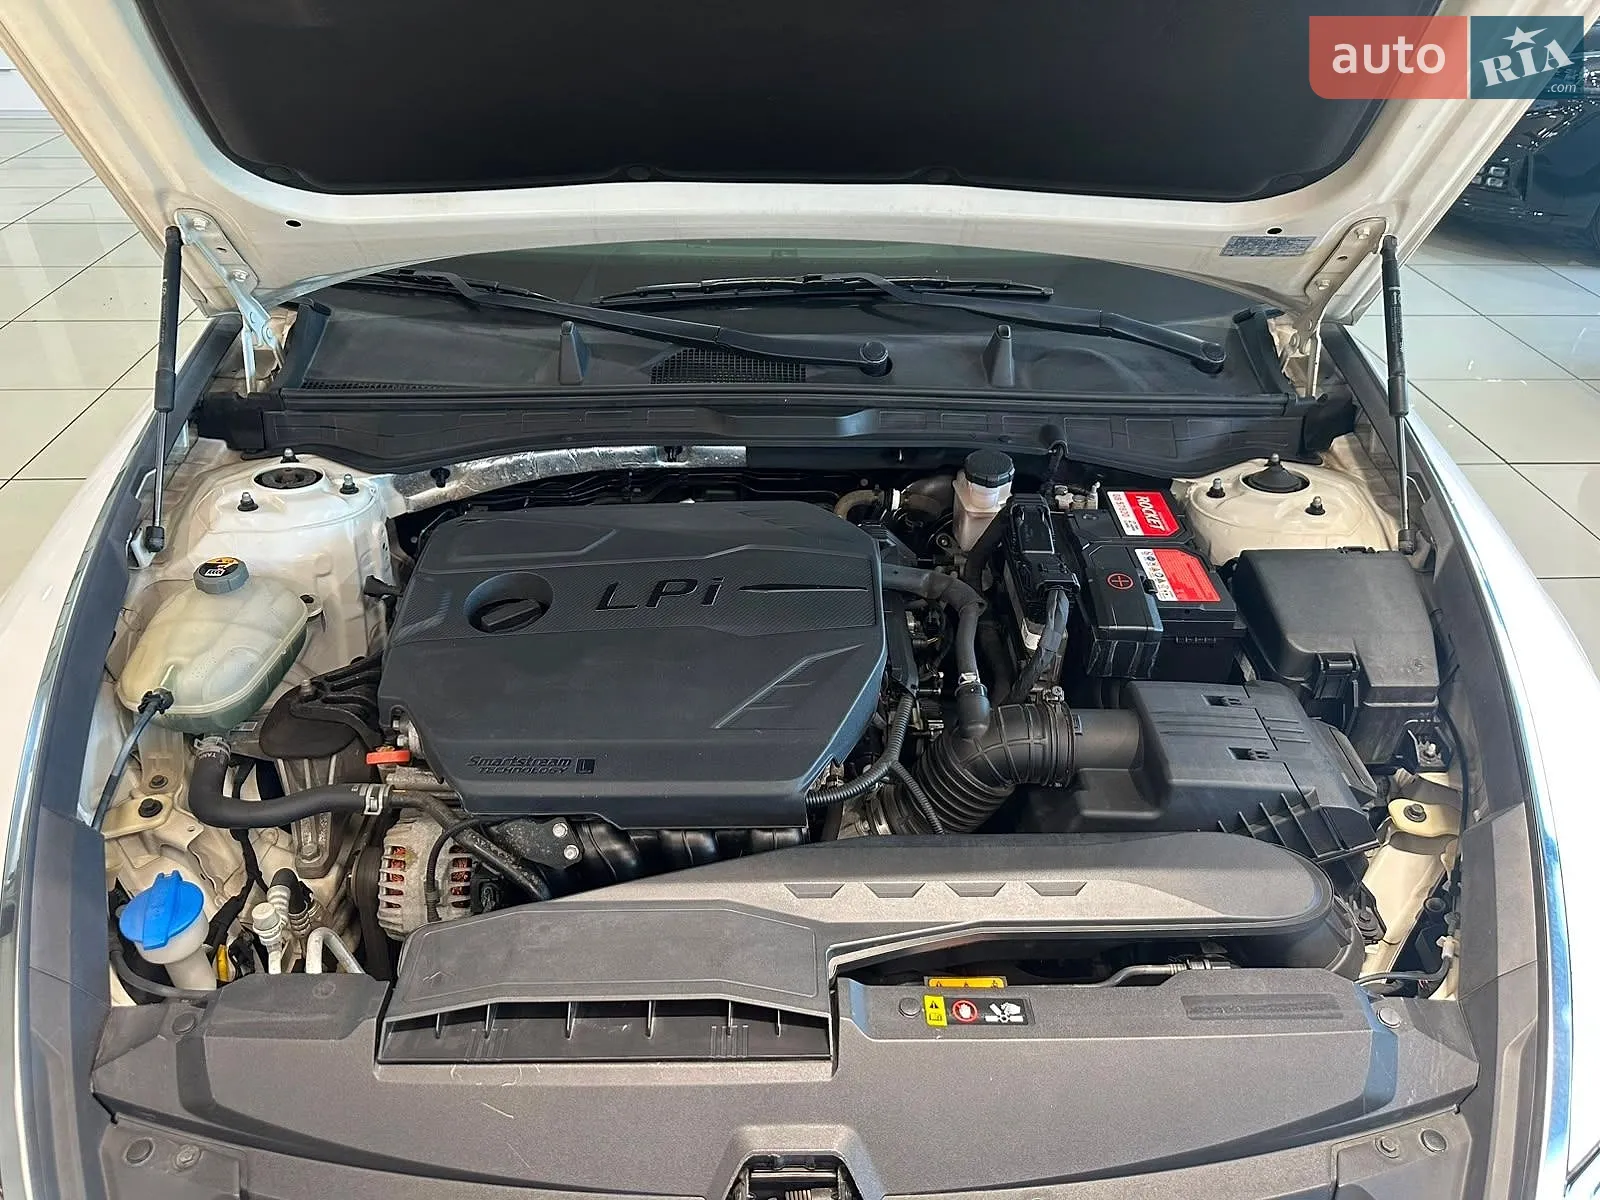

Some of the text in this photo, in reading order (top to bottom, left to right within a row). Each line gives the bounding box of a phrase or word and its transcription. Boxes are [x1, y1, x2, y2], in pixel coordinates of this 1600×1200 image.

[1135, 495, 1167, 532] ROCKET
[594, 577, 725, 612] LPi
[466, 755, 573, 768] Smartstream
[478, 766, 570, 774] TECHNOLOGY
